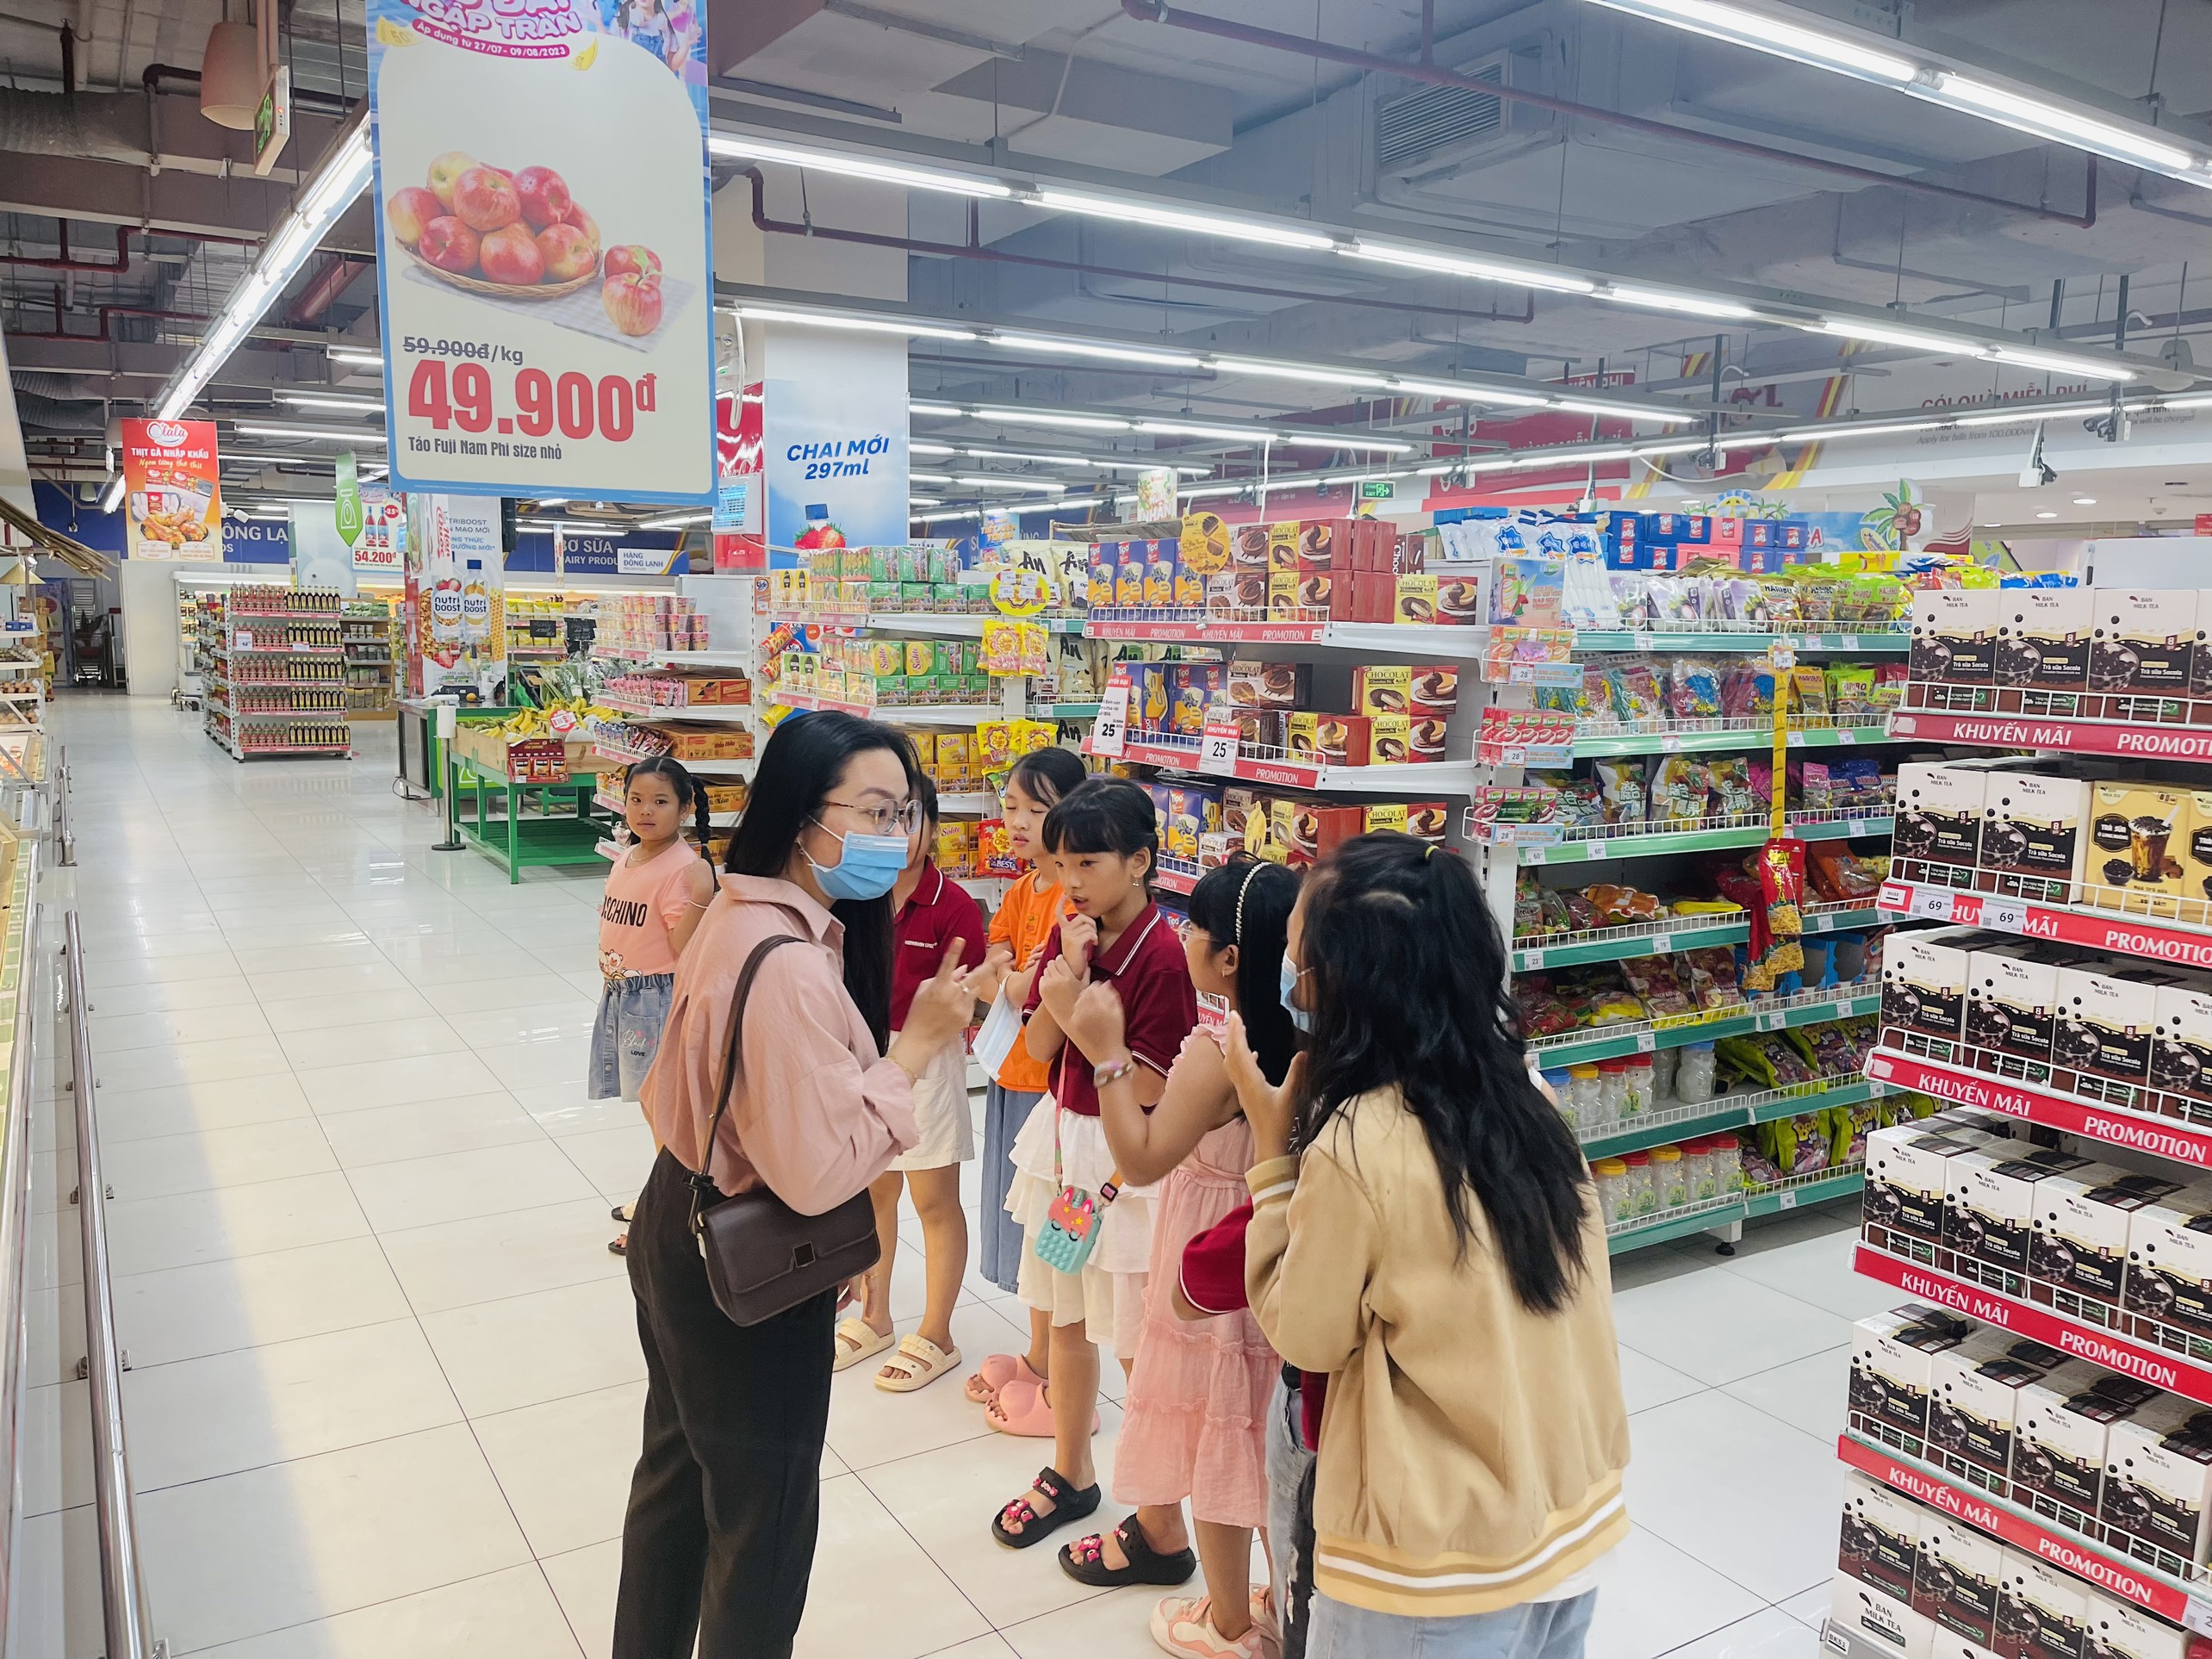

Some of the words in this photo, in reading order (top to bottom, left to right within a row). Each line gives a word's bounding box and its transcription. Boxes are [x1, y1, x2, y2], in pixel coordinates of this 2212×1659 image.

[494, 11, 583, 40] TRÀN
[416, 23, 431, 35] Áp
[433, 30, 459, 48] dụng
[509, 47, 566, 58] 09/08/2023
[408, 359, 656, 442] 49.900đ
[131, 447, 148, 458] THỊT
[150, 446, 162, 458] GÀ
[164, 448, 186, 459] NHẬP
[188, 447, 209, 459] KHẨU
[408, 437, 431, 452] Táo
[434, 438, 457, 455] Fuji
[460, 440, 488, 456] Nam
[491, 442, 510, 458] Phi
[513, 443, 537, 459] size
[540, 443, 562, 460] nhỏ
[786, 441, 842, 462] CHAI
[847, 434, 890, 457] MỚI
[805, 458, 869, 480] 297ml
[583, 537, 613, 554] SỮA
[355, 550, 397, 564] 54.200đ
[563, 556, 586, 564] AIRY
[434, 604, 461, 612] boost
[435, 596, 460, 605] nutri
[1102, 624, 1123, 637] KHUYẾN
[1150, 628, 1186, 638] PROMOTION
[1202, 625, 1227, 640] KHUYẾN
[1262, 629, 1306, 641] PROMOTION
[1059, 636, 1083, 661] An
[1115, 665, 1127, 675] Tipo
[1177, 667, 1190, 677] Tipo
[1207, 668, 1219, 679] Tipo
[1102, 724, 1115, 737] 25
[1372, 719, 1410, 728] CHOCOLAT
[1056, 719, 1081, 745] An
[1952, 722, 2028, 743] KHUYẾN
[2032, 724, 2072, 746] MÃI
[940, 737, 960, 748] Solite
[1213, 742, 1227, 758] 25
[1145, 754, 1181, 767] PROMOTION
[1256, 767, 1299, 785] PROMOTION
[1171, 792, 1184, 803] Tipo
[1367, 810, 1407, 818] CHOCOLAT
[941, 825, 961, 836] Solite
[601, 895, 648, 928] SCHINO
[1928, 900, 1942, 910] 69
[1999, 912, 2014, 923] 69
[1918, 1073, 1990, 1106] KHUYẾN
[1993, 1092, 2031, 1117] MÃI
[2085, 1115, 2207, 1163] PROMOTION
[1895, 1154, 1906, 1163] MILK
[1900, 1271, 1969, 1311] KHUYẾN
[1973, 1302, 2010, 1326] MÃI
[2060, 1330, 2177, 1388] PROMOTION
[1889, 1466, 1960, 1513] KHUYẾN
[1964, 1504, 1999, 1531] MÃI
[2039, 1537, 2153, 1604] PROMOTION
[1875, 1603, 1892, 1618] BAN
[1865, 1607, 1886, 1625] MILK
[1887, 1619, 1902, 1633] TEA
